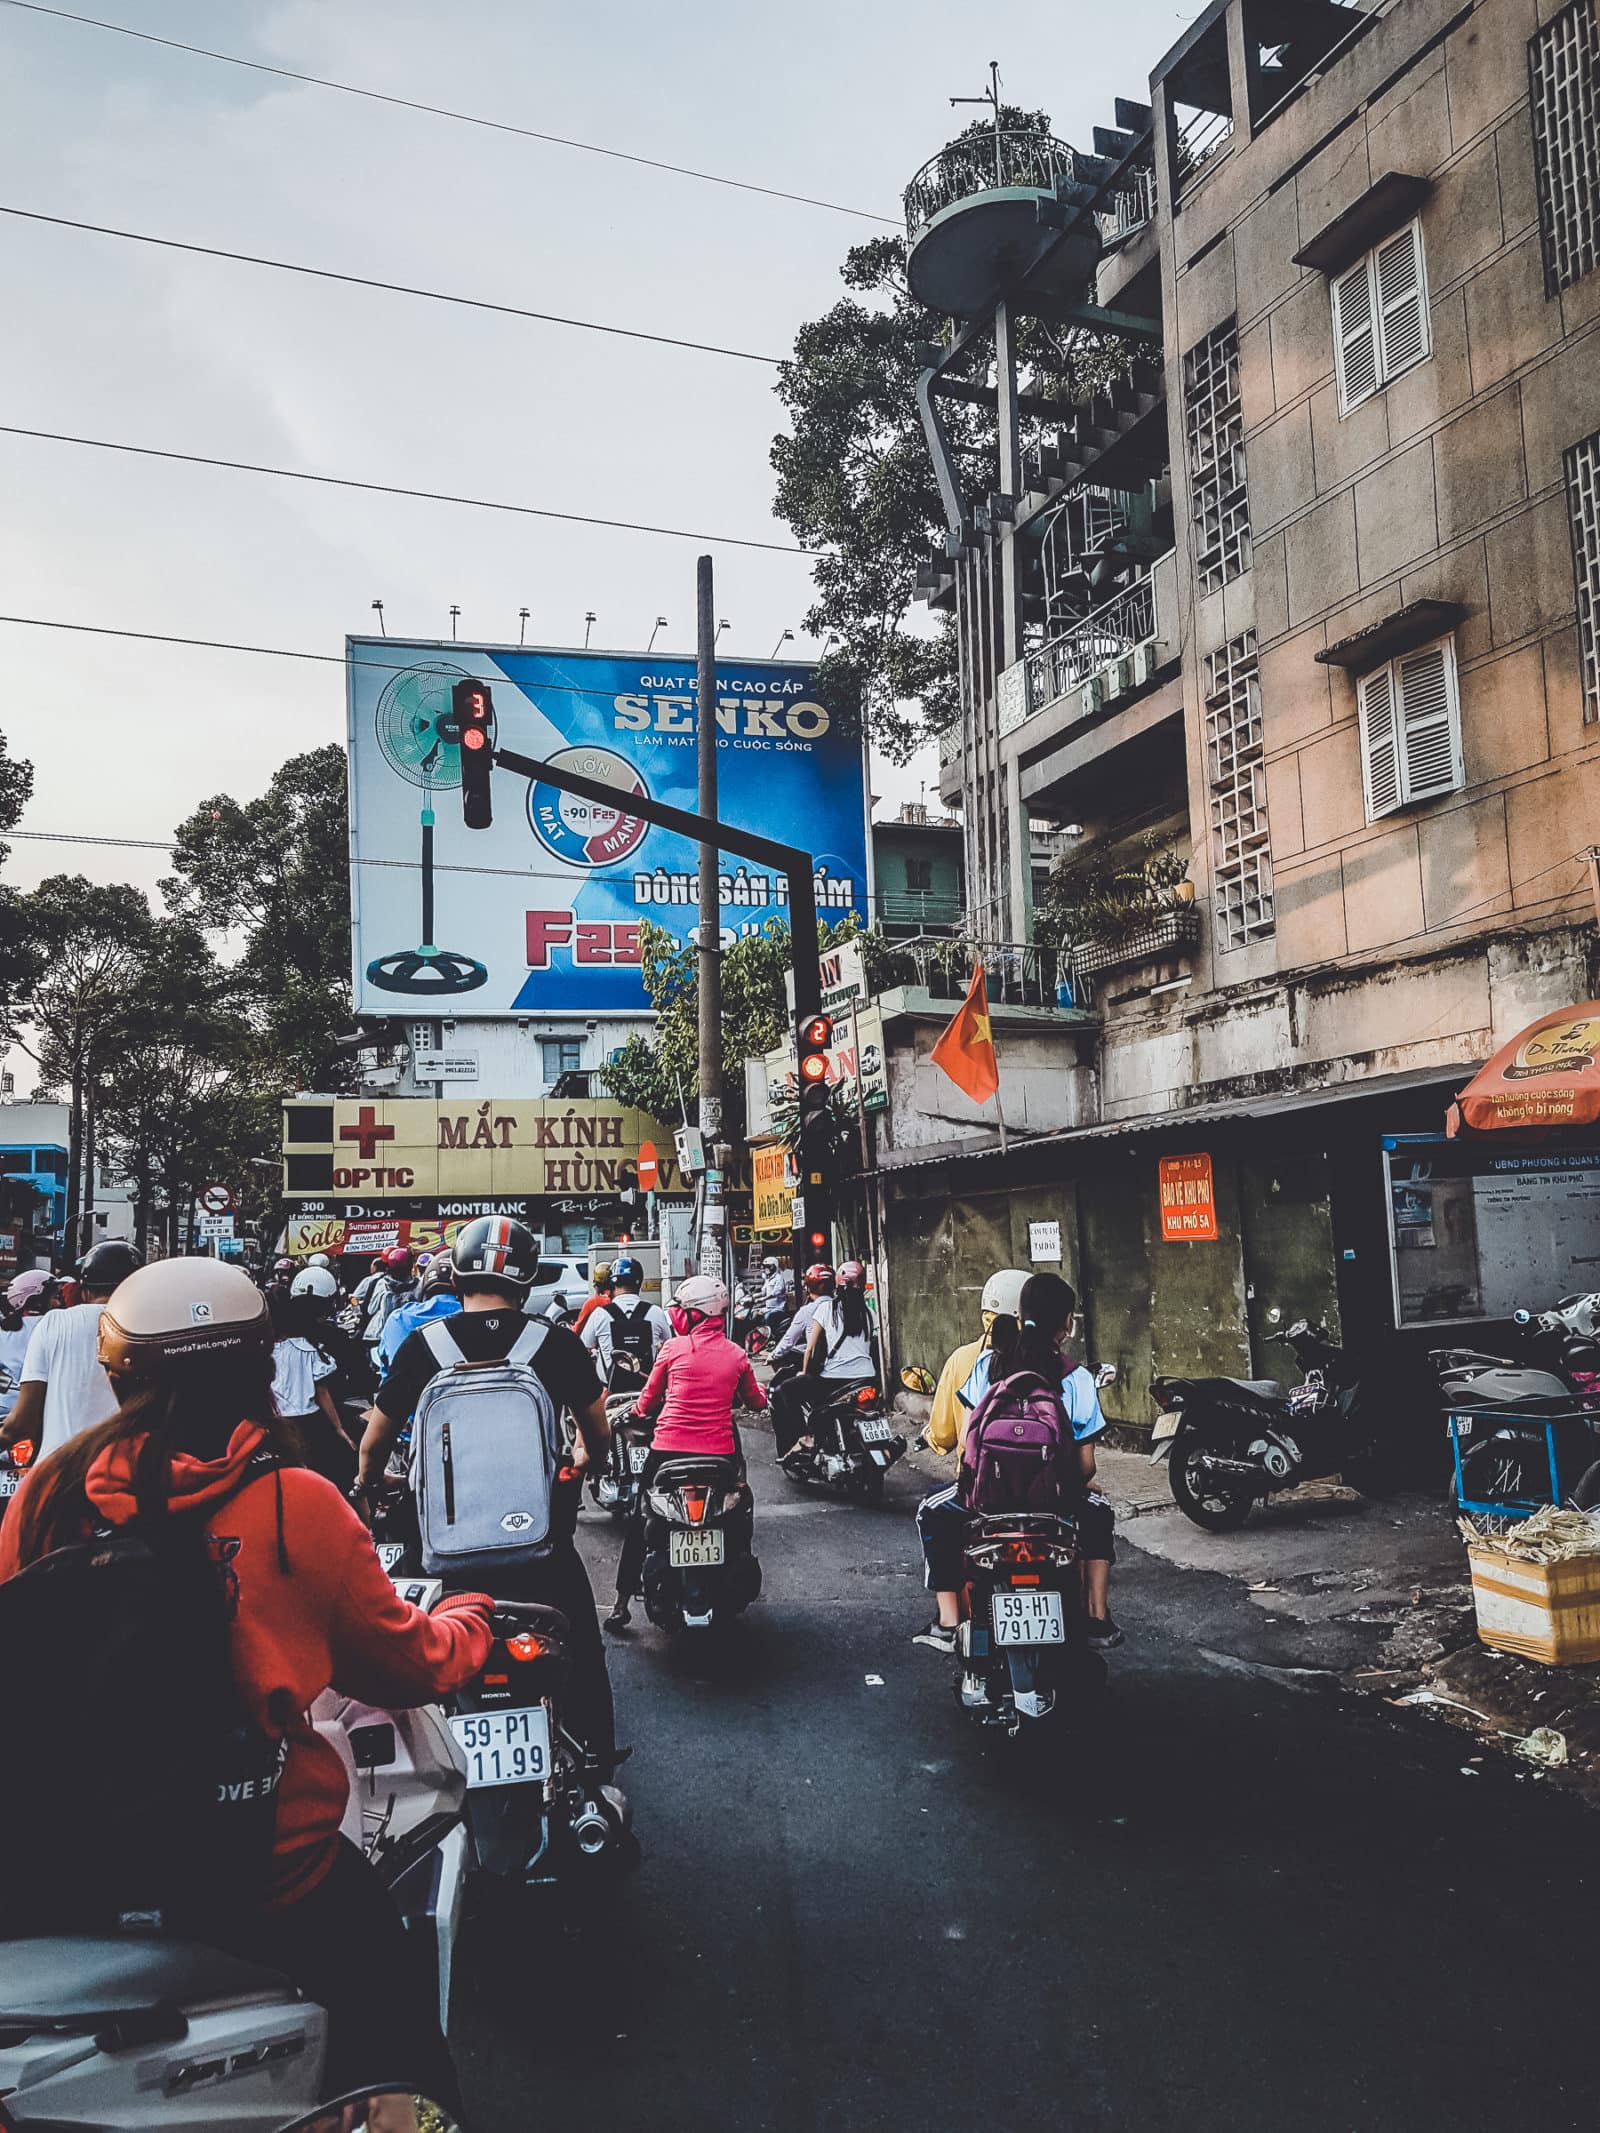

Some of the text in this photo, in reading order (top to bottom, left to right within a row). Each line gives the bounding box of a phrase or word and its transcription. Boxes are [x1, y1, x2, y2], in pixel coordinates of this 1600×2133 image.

[640, 675, 686, 691] QUẠT
[688, 677, 728, 691] ĐN
[731, 680, 766, 693] CAO
[472, 693, 485, 718] 3
[613, 692, 830, 738] SENKO
[539, 806, 566, 840] MÁT
[717, 868, 769, 906] SẢN
[776, 867, 853, 907] PẨM
[813, 1022, 824, 1041] 2
[438, 1101, 624, 1150] MẮT KÍNH
[1495, 1159, 1520, 1169] UBND
[333, 1167, 414, 1189] OPTIC
[1184, 1179, 1197, 1205] KHU
[301, 1201, 325, 1212] 300
[344, 1204, 396, 1218] Dior
[438, 1202, 527, 1216] MONTBLANC
[348, 1221, 400, 1231] Summer 2019
[1166, 1209, 1210, 1230] KHU PHỐ 5A
[298, 1221, 344, 1250] Sale
[679, 1531, 715, 1547] 70-F1
[675, 1546, 721, 1564] 106.13
[1003, 1596, 1050, 1618] 59-H1
[999, 1618, 1060, 1640] 791.73
[481, 1692, 511, 1700] HONDA
[463, 1713, 530, 1749] 59-P1
[473, 1745, 544, 1780] 11.99
